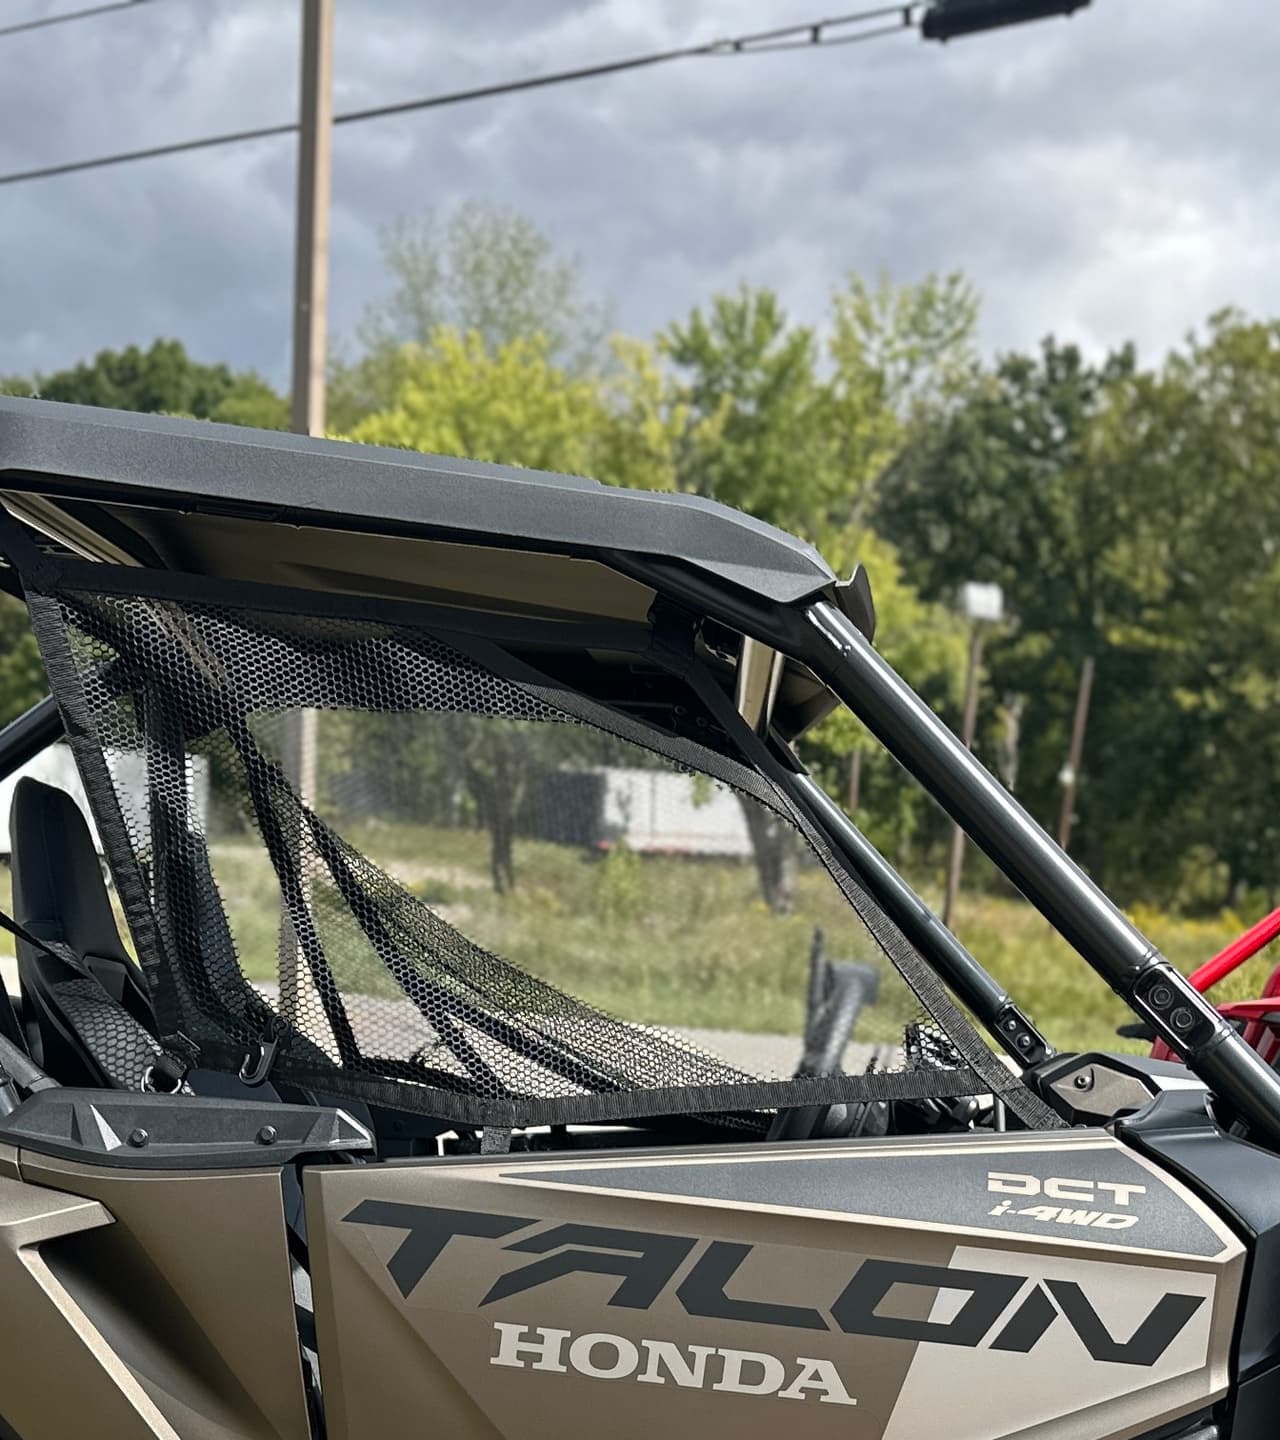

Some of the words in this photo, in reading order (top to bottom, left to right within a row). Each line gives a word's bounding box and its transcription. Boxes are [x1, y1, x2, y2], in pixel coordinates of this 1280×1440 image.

[987, 1171, 1147, 1207] DCT
[989, 1199, 1139, 1230] i-4WD
[340, 1199, 1207, 1367] TALON
[489, 1321, 858, 1406] HONDA
